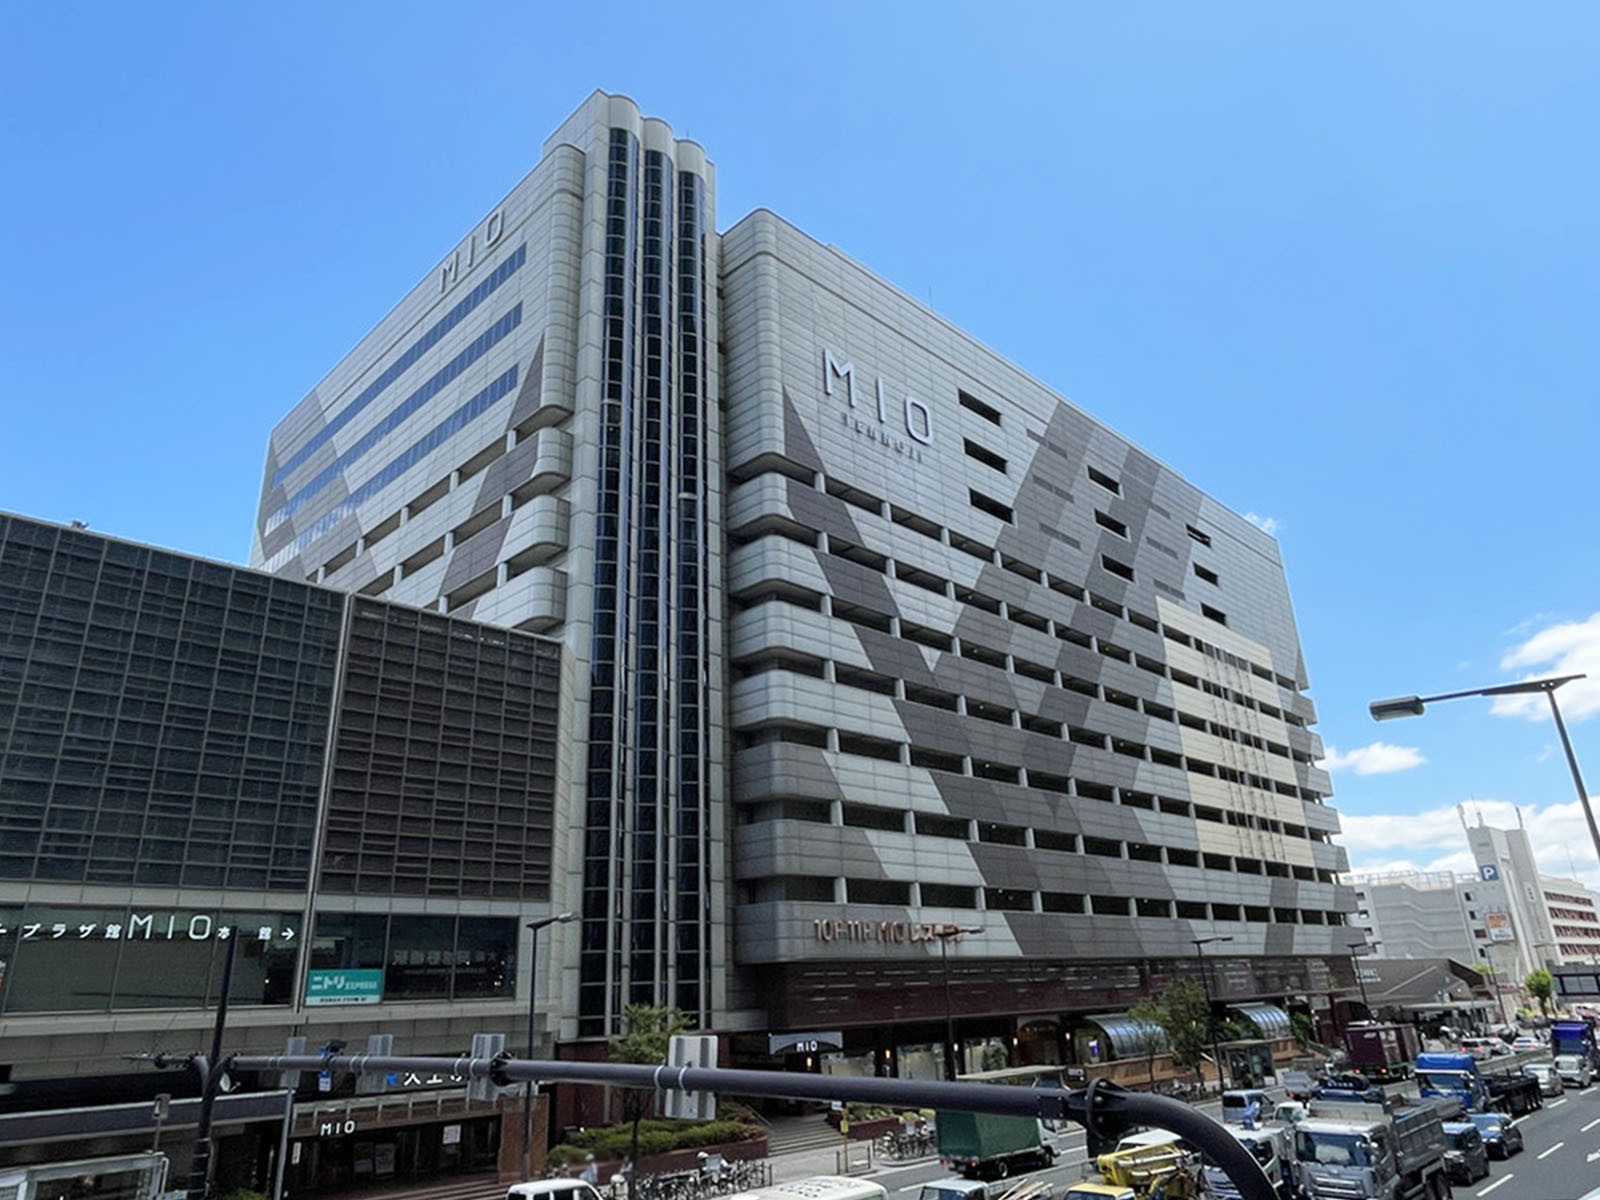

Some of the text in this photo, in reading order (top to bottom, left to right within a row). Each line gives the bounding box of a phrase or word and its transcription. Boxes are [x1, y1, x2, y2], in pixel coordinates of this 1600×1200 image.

[440, 208, 505, 294] MIO
[822, 347, 934, 447] MIO
[1482, 866, 1495, 880] P
[127, 913, 212, 940] MIO
[311, 975, 345, 990] ニトリ
[796, 1039, 818, 1053] MIO
[320, 1120, 356, 1137] MIO
